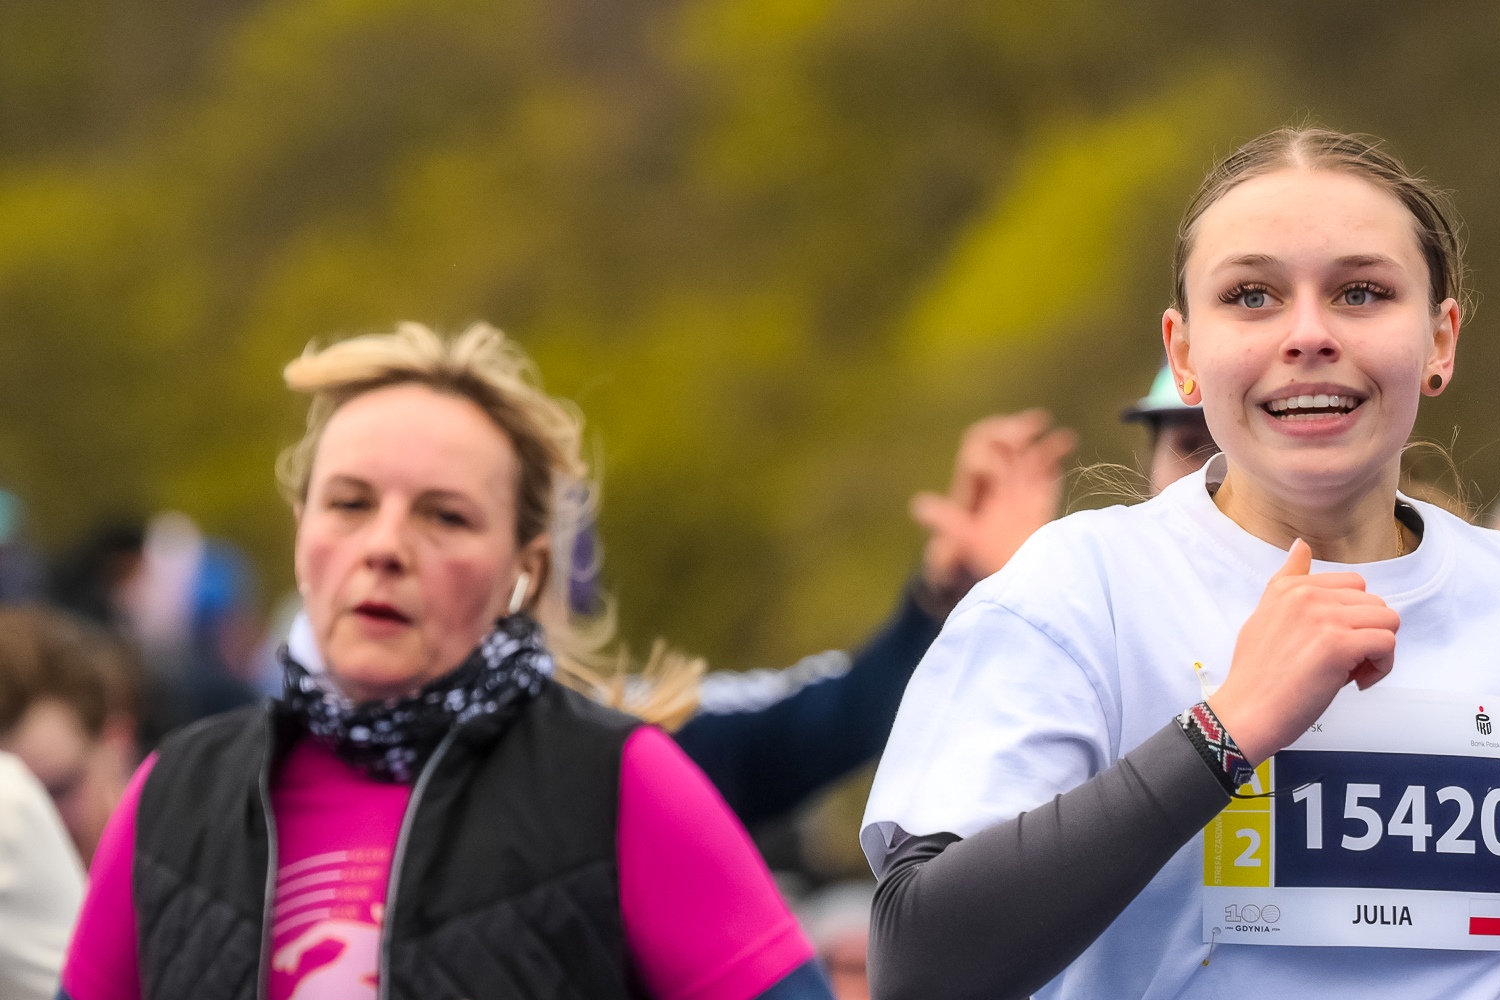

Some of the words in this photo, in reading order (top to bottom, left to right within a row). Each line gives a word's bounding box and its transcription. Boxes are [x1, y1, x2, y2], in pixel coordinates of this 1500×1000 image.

[1234, 828, 1262, 867] 2
[1352, 905, 1413, 926] JULIA
[1235, 925, 1270, 933] GDYNIA
